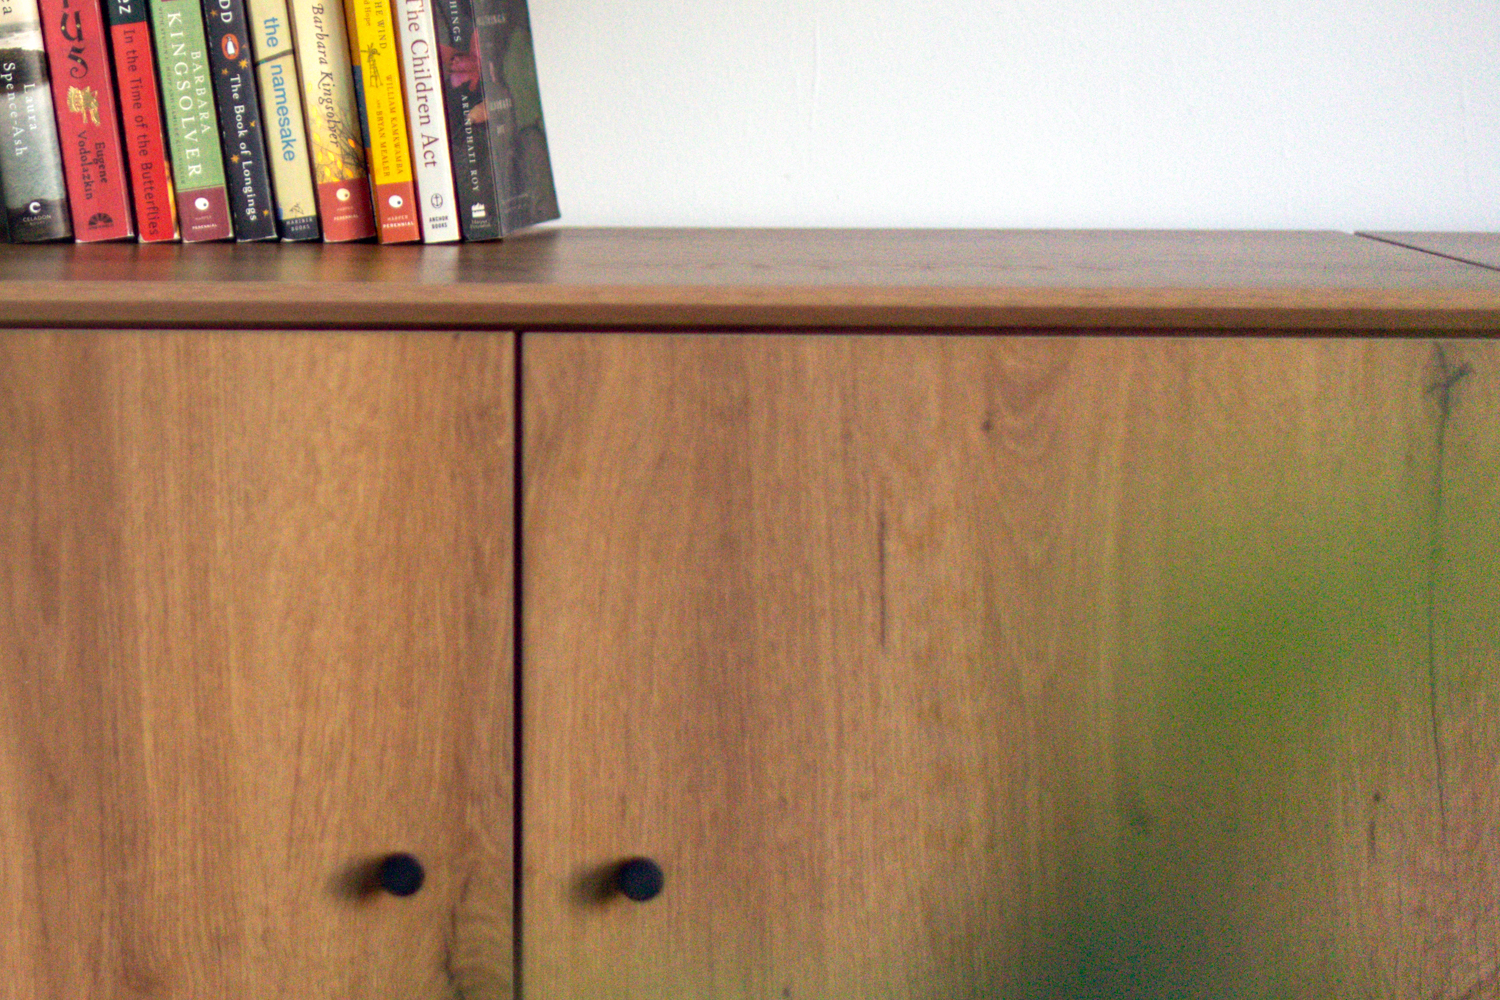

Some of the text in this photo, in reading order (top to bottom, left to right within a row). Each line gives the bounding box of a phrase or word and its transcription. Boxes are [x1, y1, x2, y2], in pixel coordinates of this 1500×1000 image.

[264, 16, 280, 48] the
[363, 6, 372, 26] Hope
[377, 20, 387, 49] WIND
[23, 83, 38, 130] Laura
[167, 11, 202, 177] KINGSOLVER
[190, 51, 211, 134] BARBARA
[311, 3, 341, 148] Barbara Kingsolver
[386, 74, 397, 114] WILLIAM
[410, 39, 434, 126] Children
[0, 62, 28, 156] Spence-Ash
[123, 29, 159, 236] In the Time of the Butterflies
[270, 64, 296, 162] namesake
[376, 111, 386, 139] BRYAN
[77, 130, 93, 200] Vodolazkin
[92, 142, 108, 183] Eugene
[230, 74, 257, 221] The Book of Longings
[380, 141, 390, 177] MEALER
[390, 116, 403, 175] KAMKWAMBA
[421, 133, 439, 168] Act
[461, 94, 480, 192] ARUNDHATI ROY
